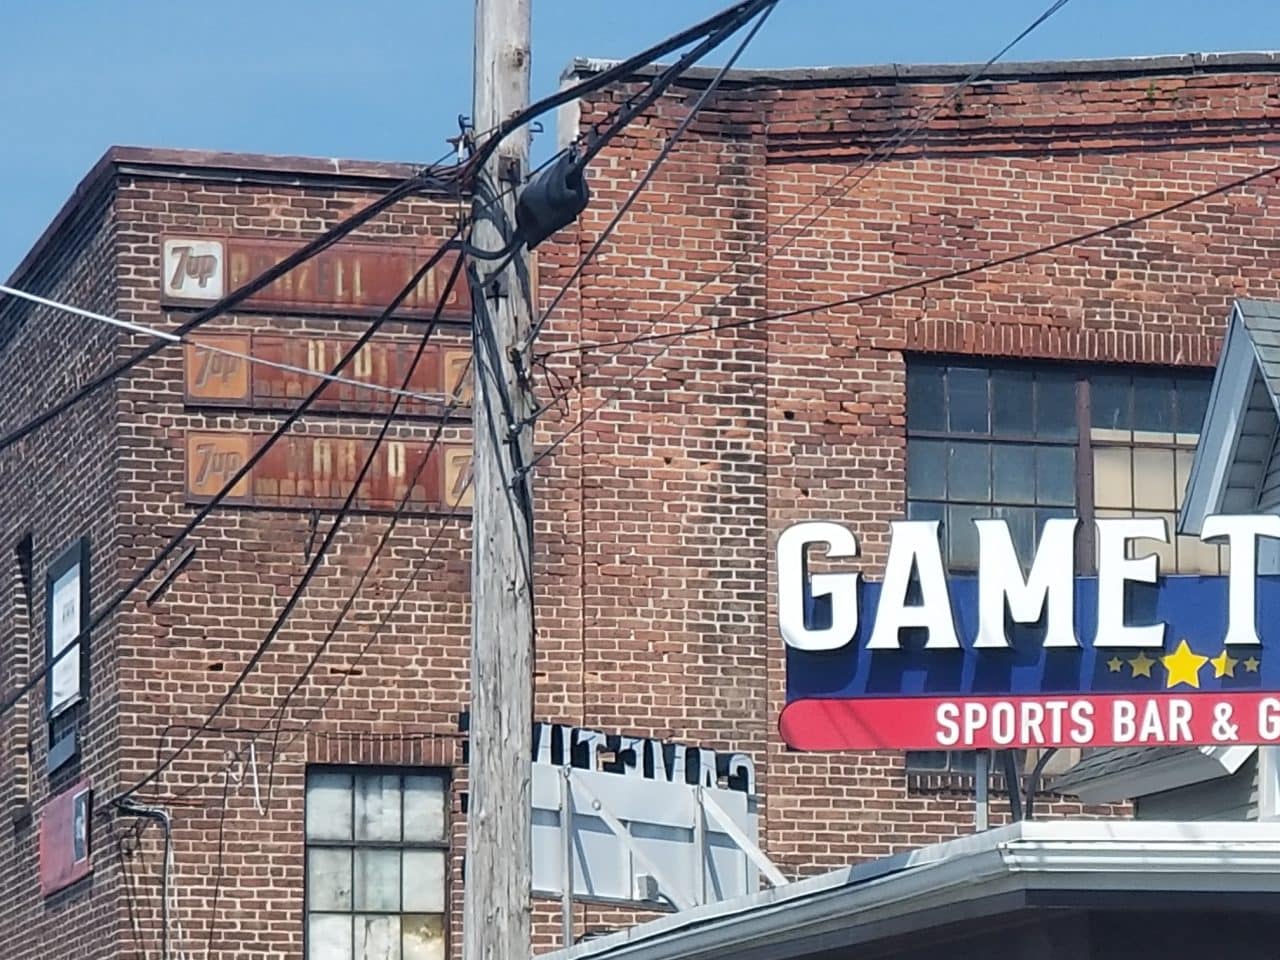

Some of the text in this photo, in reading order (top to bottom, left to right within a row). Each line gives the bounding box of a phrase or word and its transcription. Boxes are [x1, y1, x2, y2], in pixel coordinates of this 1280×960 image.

[776, 516, 1171, 652] GAME
[935, 701, 1095, 747] SPORTS
[1111, 699, 1194, 743] BAR
[1210, 702, 1240, 743] &
